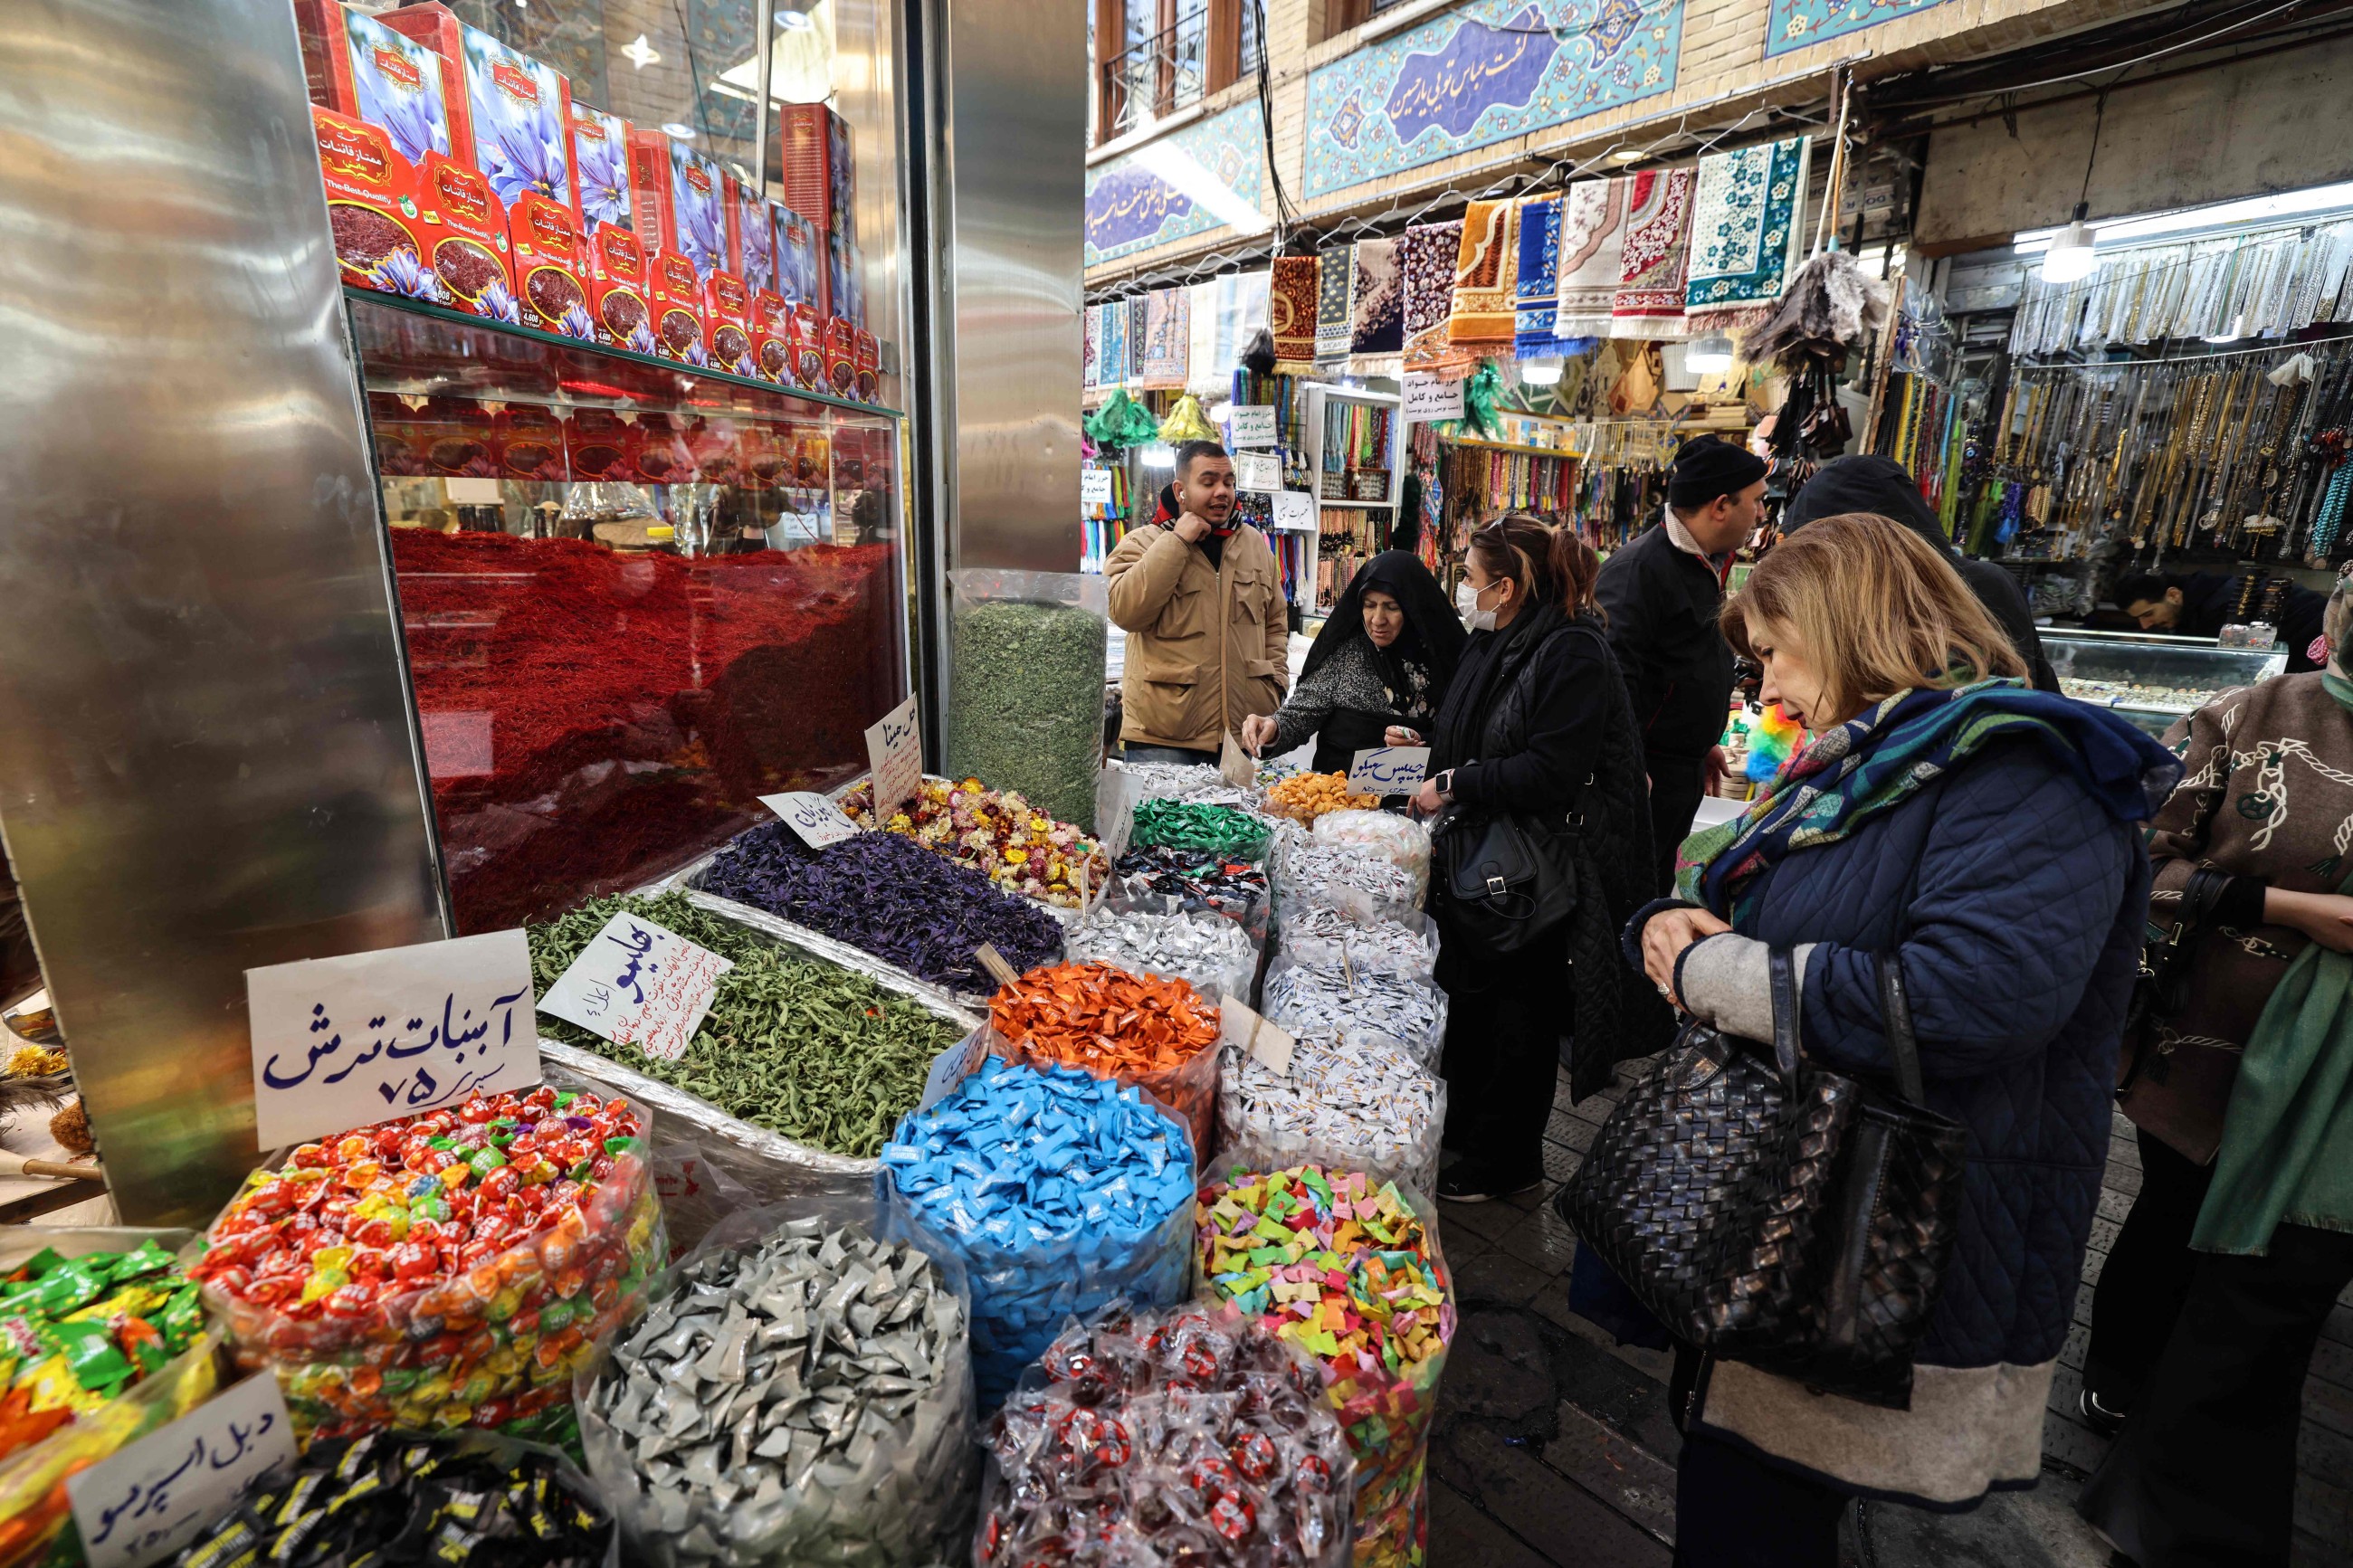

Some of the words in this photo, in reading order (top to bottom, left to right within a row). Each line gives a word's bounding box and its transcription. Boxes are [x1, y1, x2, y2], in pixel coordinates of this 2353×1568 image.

[1450, 61, 1487, 97] عباس
[319, 138, 356, 157] قائنات
[354, 148, 382, 166] ممتاز
[442, 183, 466, 199] قائنات
[465, 192, 484, 206] ممتاز
[534, 217, 556, 231] قائنات
[555, 224, 571, 238] ممتاز
[523, 312, 538, 323] 4.608
[1407, 379, 1428, 389] جواد
[1407, 392, 1426, 404] کامل
[1428, 394, 1433, 403] و
[1434, 391, 1458, 402] جامع
[1234, 422, 1248, 432] کامل
[883, 723, 902, 749] مینا
[386, 985, 529, 1064] آبنبات
[263, 1003, 386, 1089] ترش
[210, 1413, 274, 1470] دبل
